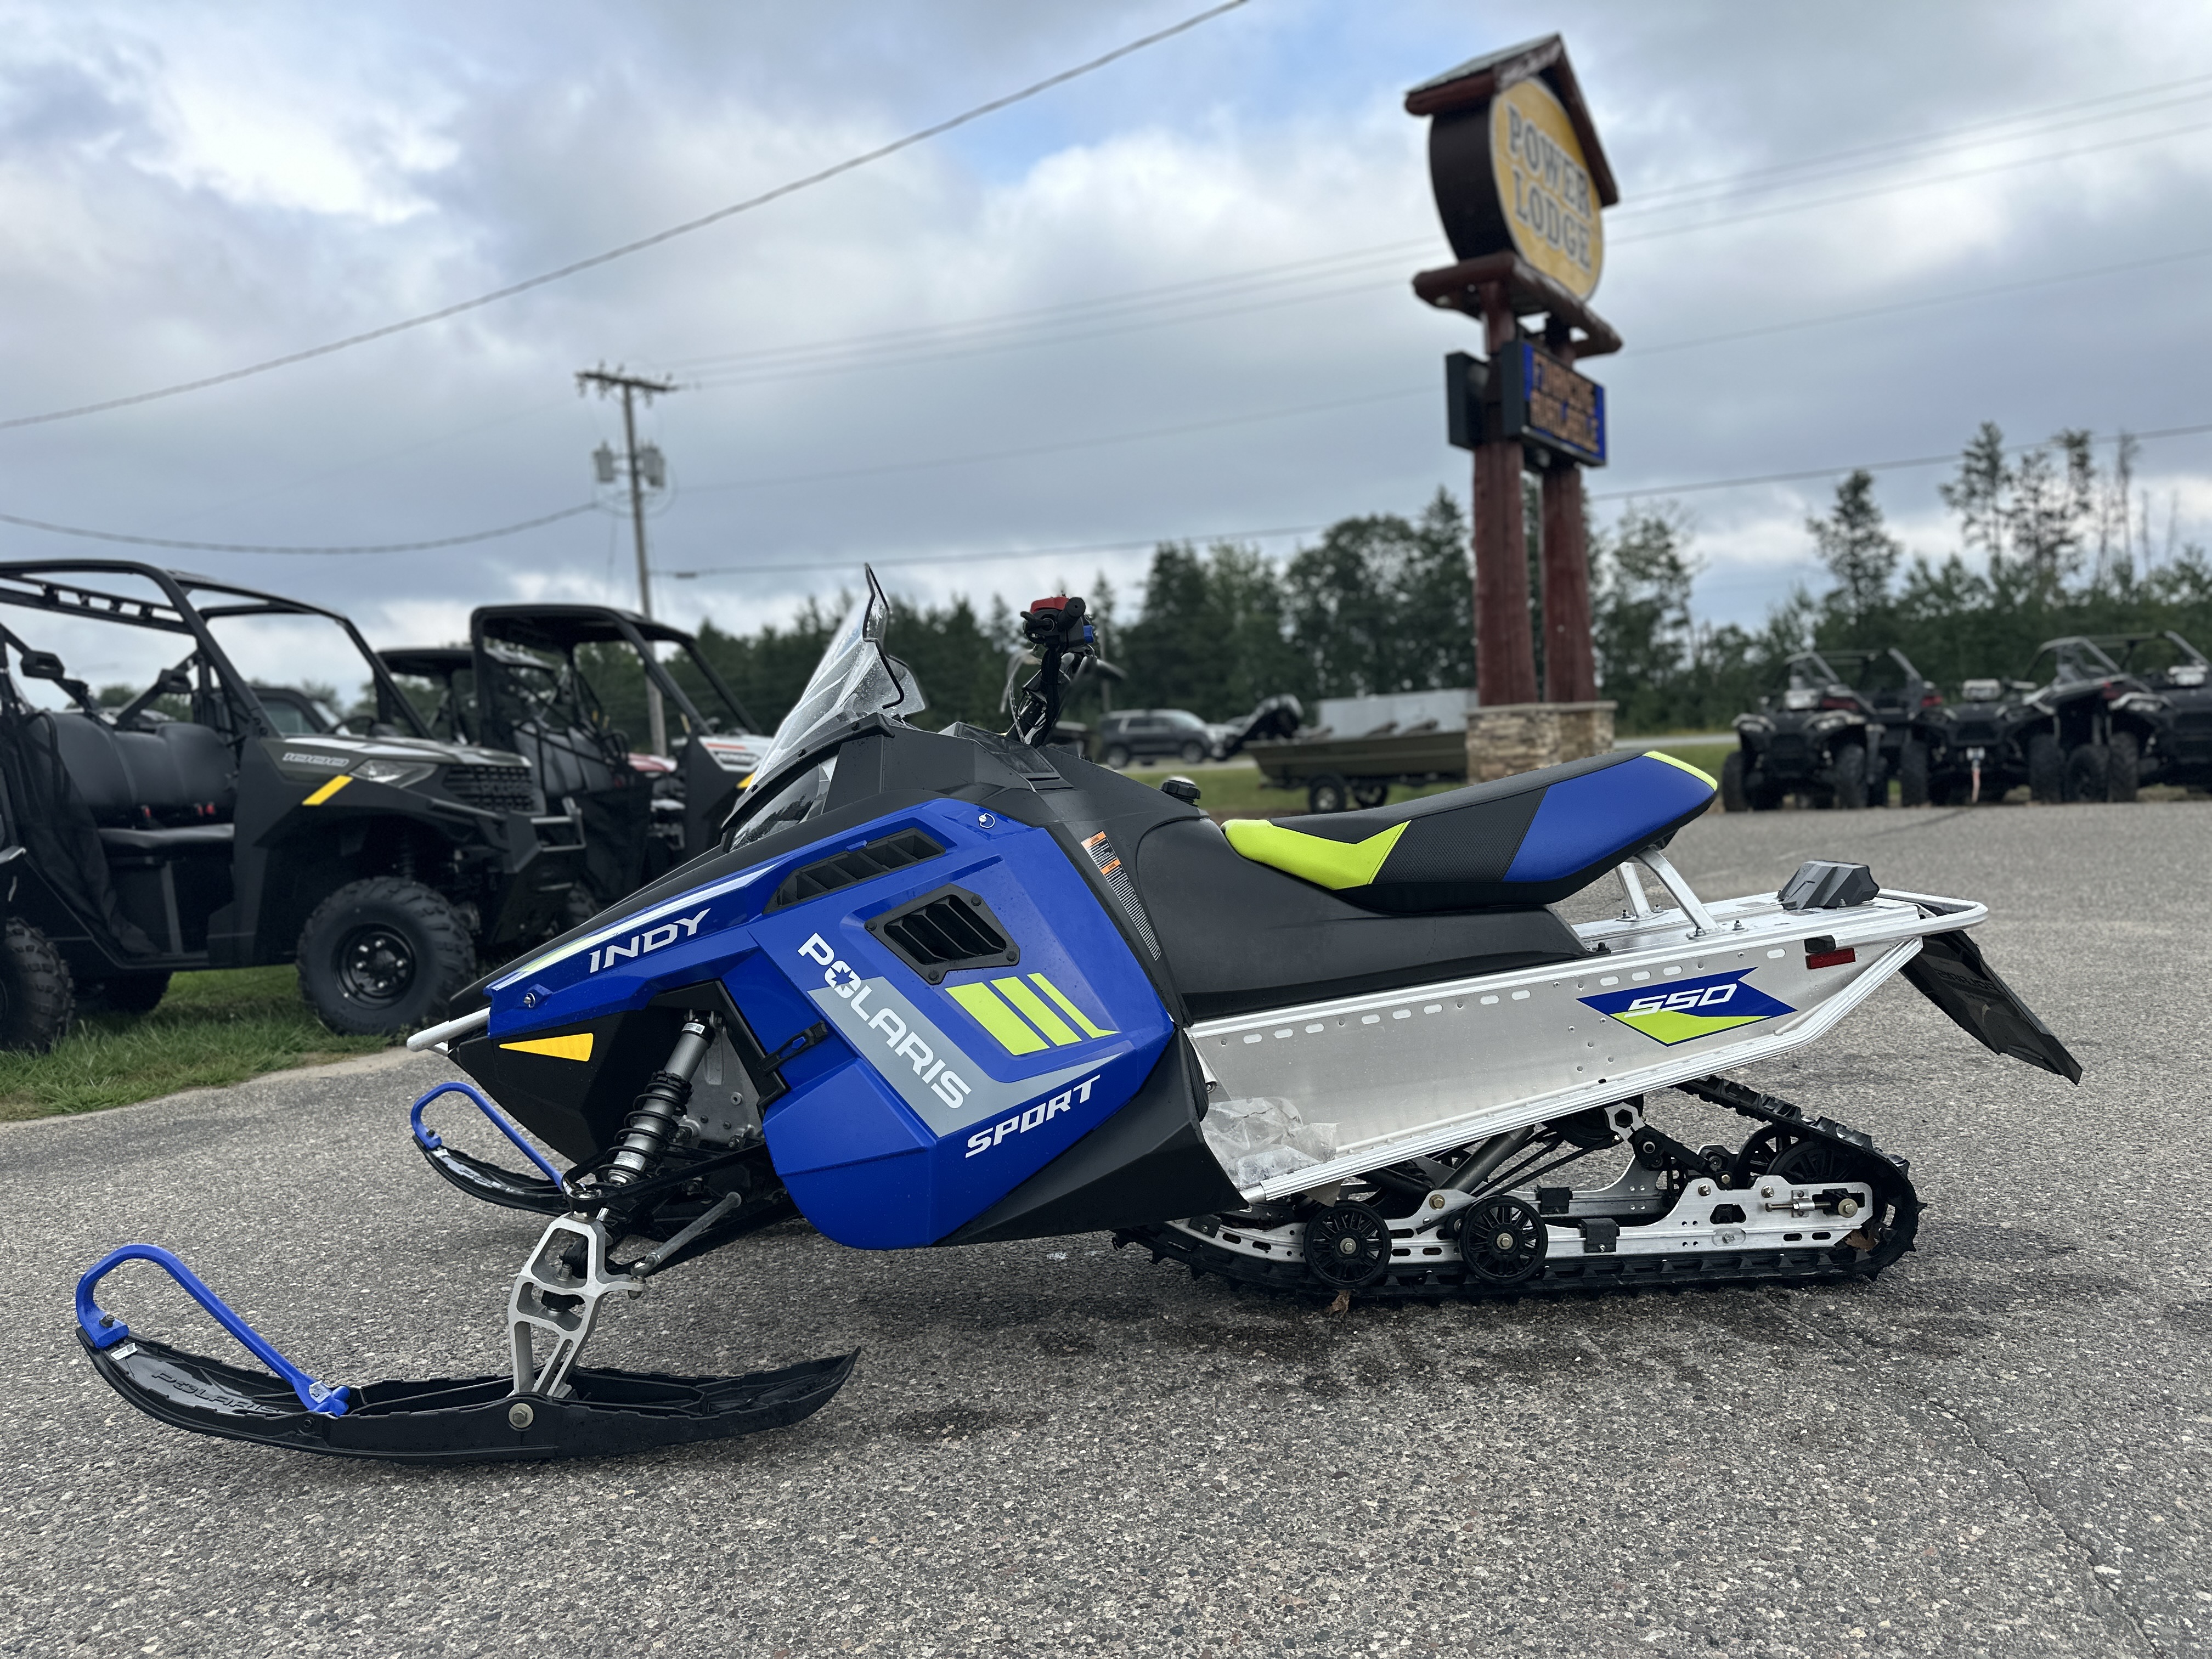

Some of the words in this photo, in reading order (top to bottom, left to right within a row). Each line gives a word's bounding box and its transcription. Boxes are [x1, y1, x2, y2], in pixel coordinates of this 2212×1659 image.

[1507, 104, 1592, 220] POWER
[1512, 166, 1591, 271] LODGE
[282, 752, 349, 767] 1000
[589, 907, 712, 974] INDY
[797, 932, 972, 1109] POLARIS
[1624, 983, 1737, 1018] 550
[965, 1074, 1101, 1158] SPORT
[151, 1372, 284, 1413] POLARIS
